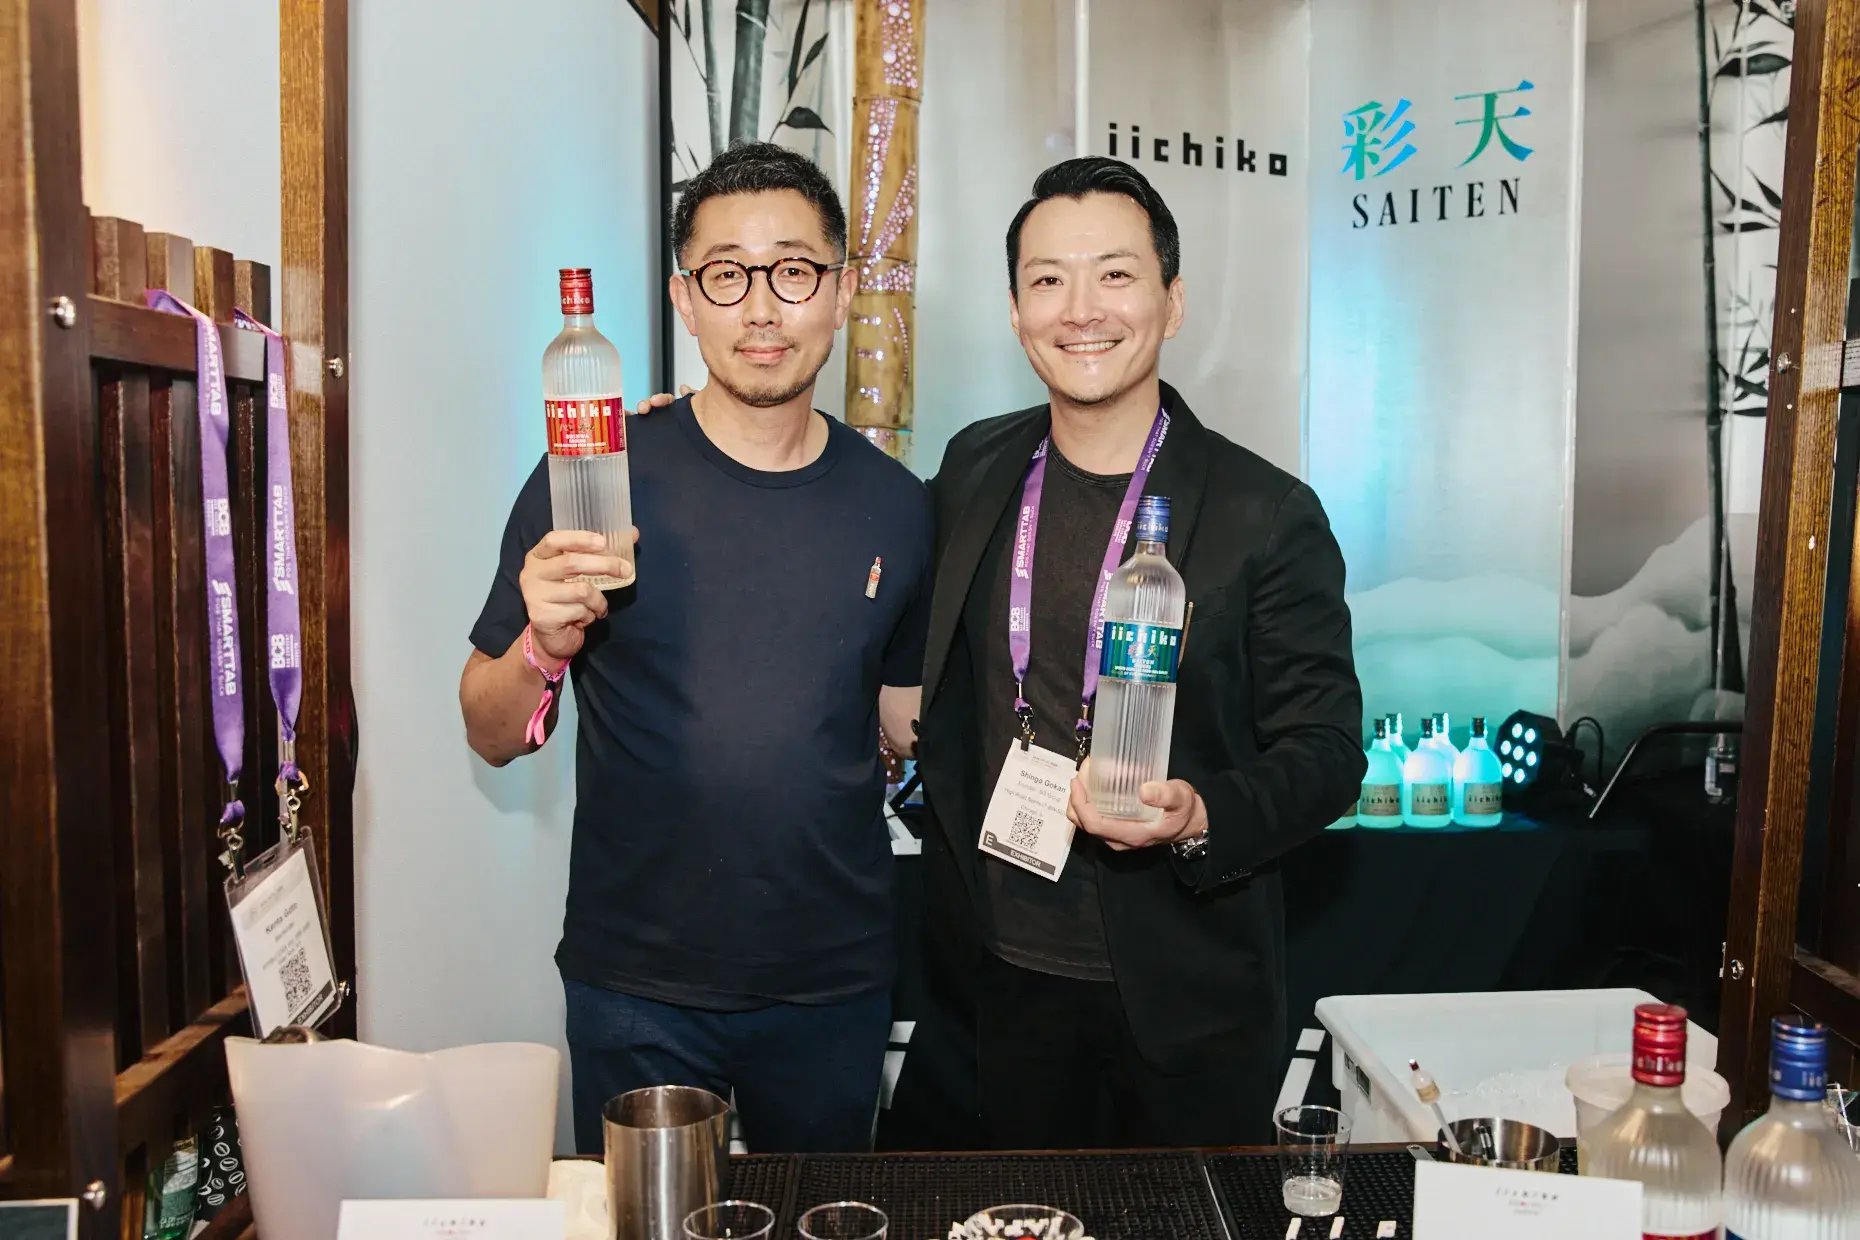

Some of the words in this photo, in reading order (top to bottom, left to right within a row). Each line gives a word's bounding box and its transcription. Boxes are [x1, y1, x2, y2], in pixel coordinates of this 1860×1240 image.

[1341, 80, 1535, 181] 彩天
[1109, 123, 1287, 176] iichiko
[1352, 177, 1521, 229] SAITEN
[547, 404, 611, 418] iichiko
[218, 498, 230, 536] BCB
[273, 485, 285, 578] SMARTTAB
[1016, 505, 1031, 568] SMARTTAB
[1010, 607, 1020, 631] BCB
[1111, 625, 1177, 646] iichiko
[221, 596, 237, 695] SMARTTAB
[272, 634, 285, 668] BCB
[1020, 770, 1043, 784] Shingo
[1045, 780, 1066, 792] Gokan
[985, 834, 994, 846] E
[1010, 850, 1041, 867] EXHIBITOR
